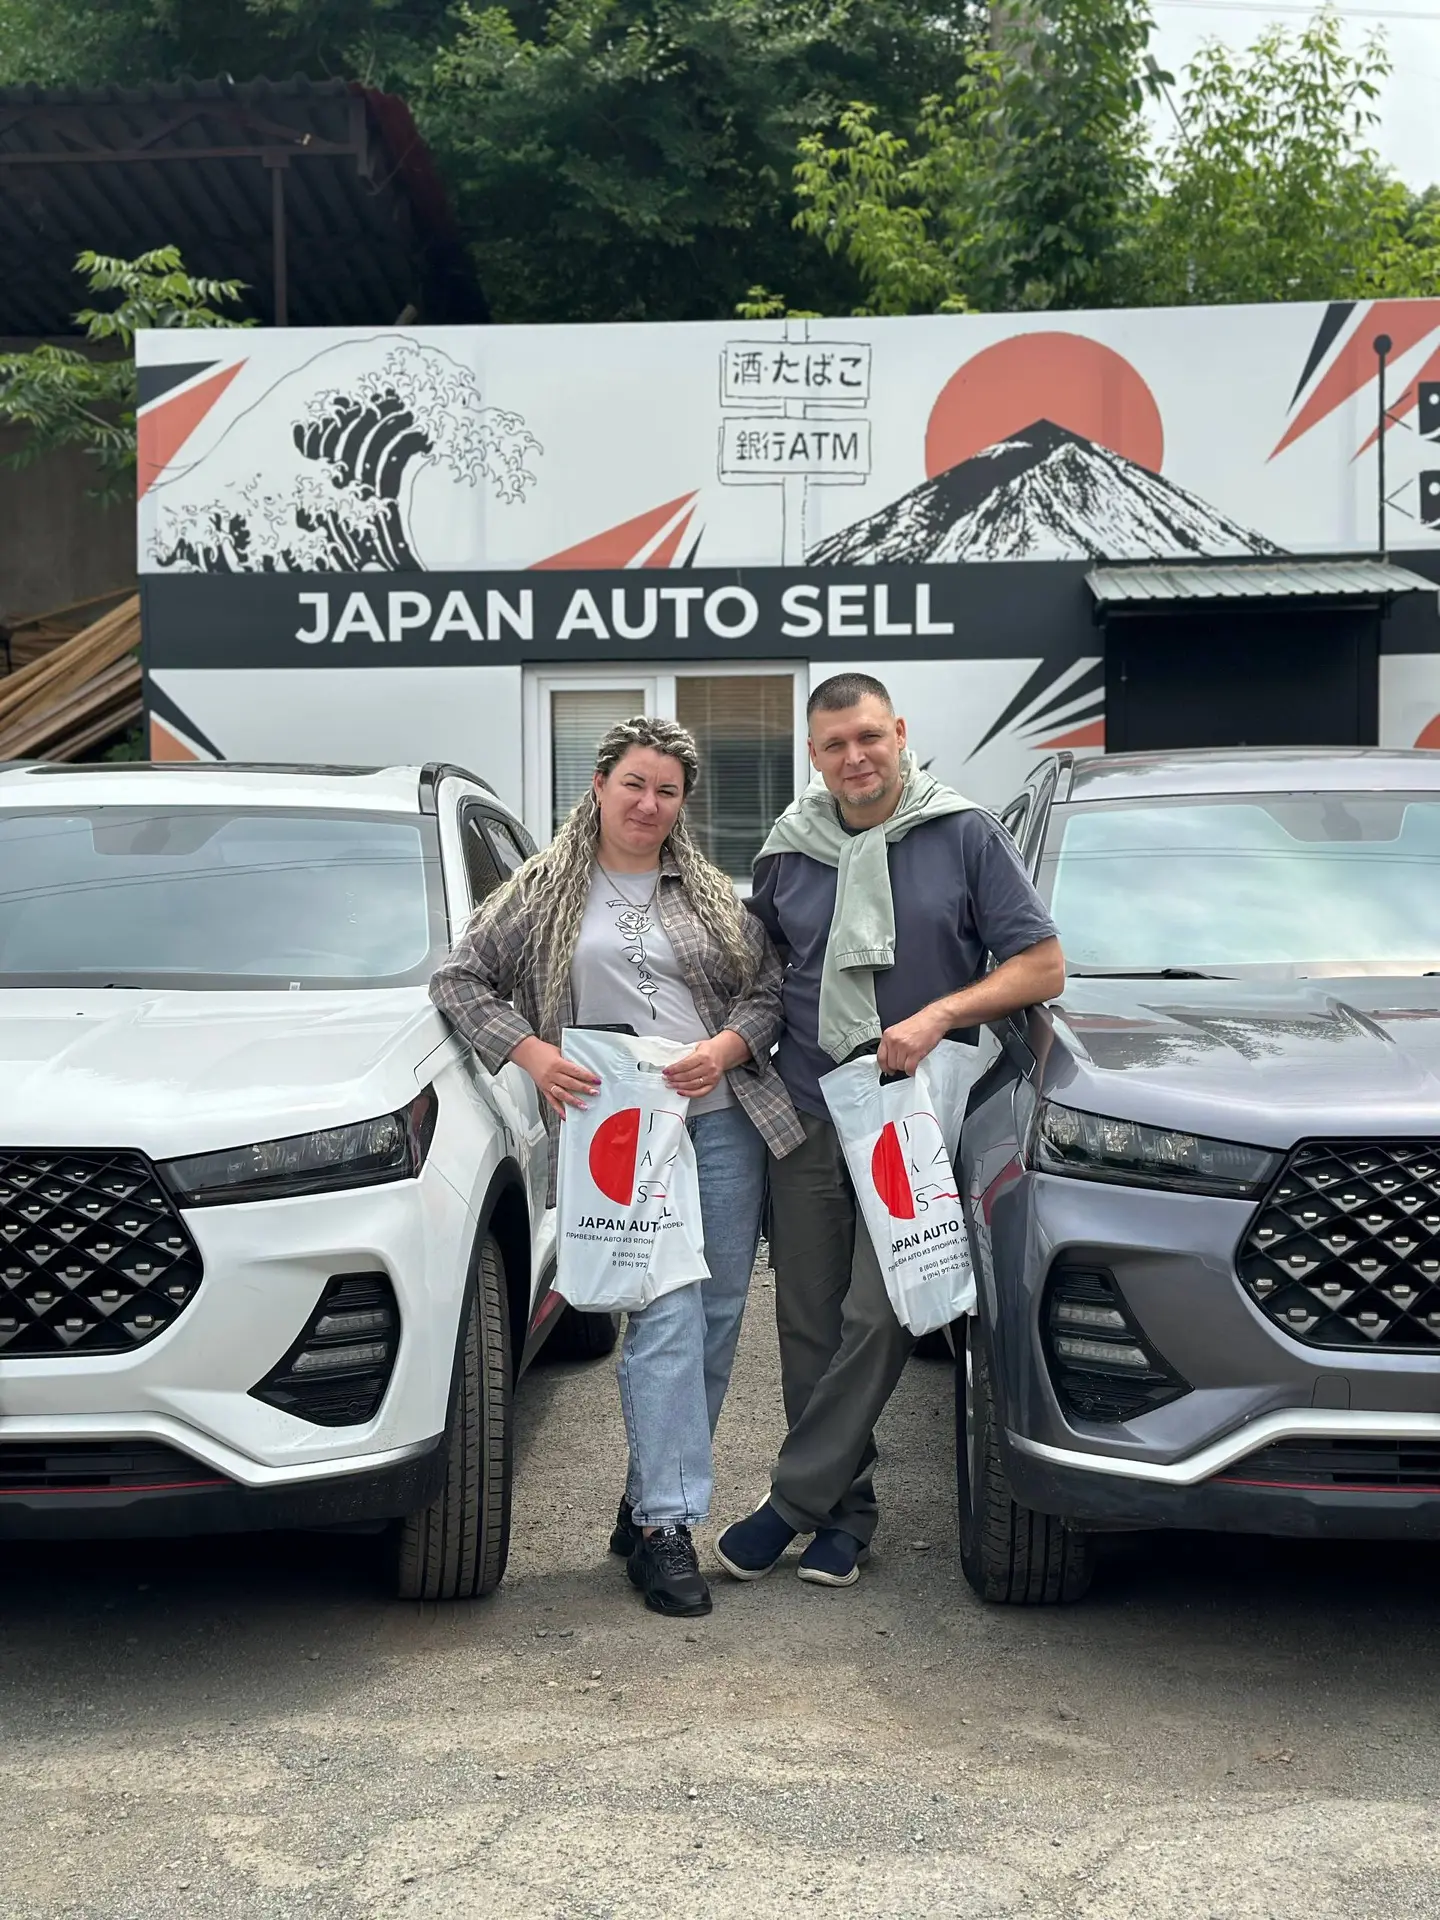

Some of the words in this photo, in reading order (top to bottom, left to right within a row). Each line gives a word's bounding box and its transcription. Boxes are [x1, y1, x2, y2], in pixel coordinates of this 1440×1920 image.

[295, 589, 533, 643] JAPAN
[556, 586, 759, 640] AUTO
[780, 583, 954, 638] SELL
[578, 1216, 625, 1231] JAPAN
[629, 1220, 659, 1233] AUT
[565, 1231, 603, 1242] ПРИВЕЗЕМ
[891, 1233, 920, 1254] APAN
[923, 1220, 959, 1242] AUTO
[617, 1251, 636, 1259] (800)
[618, 1260, 634, 1268] (914)
